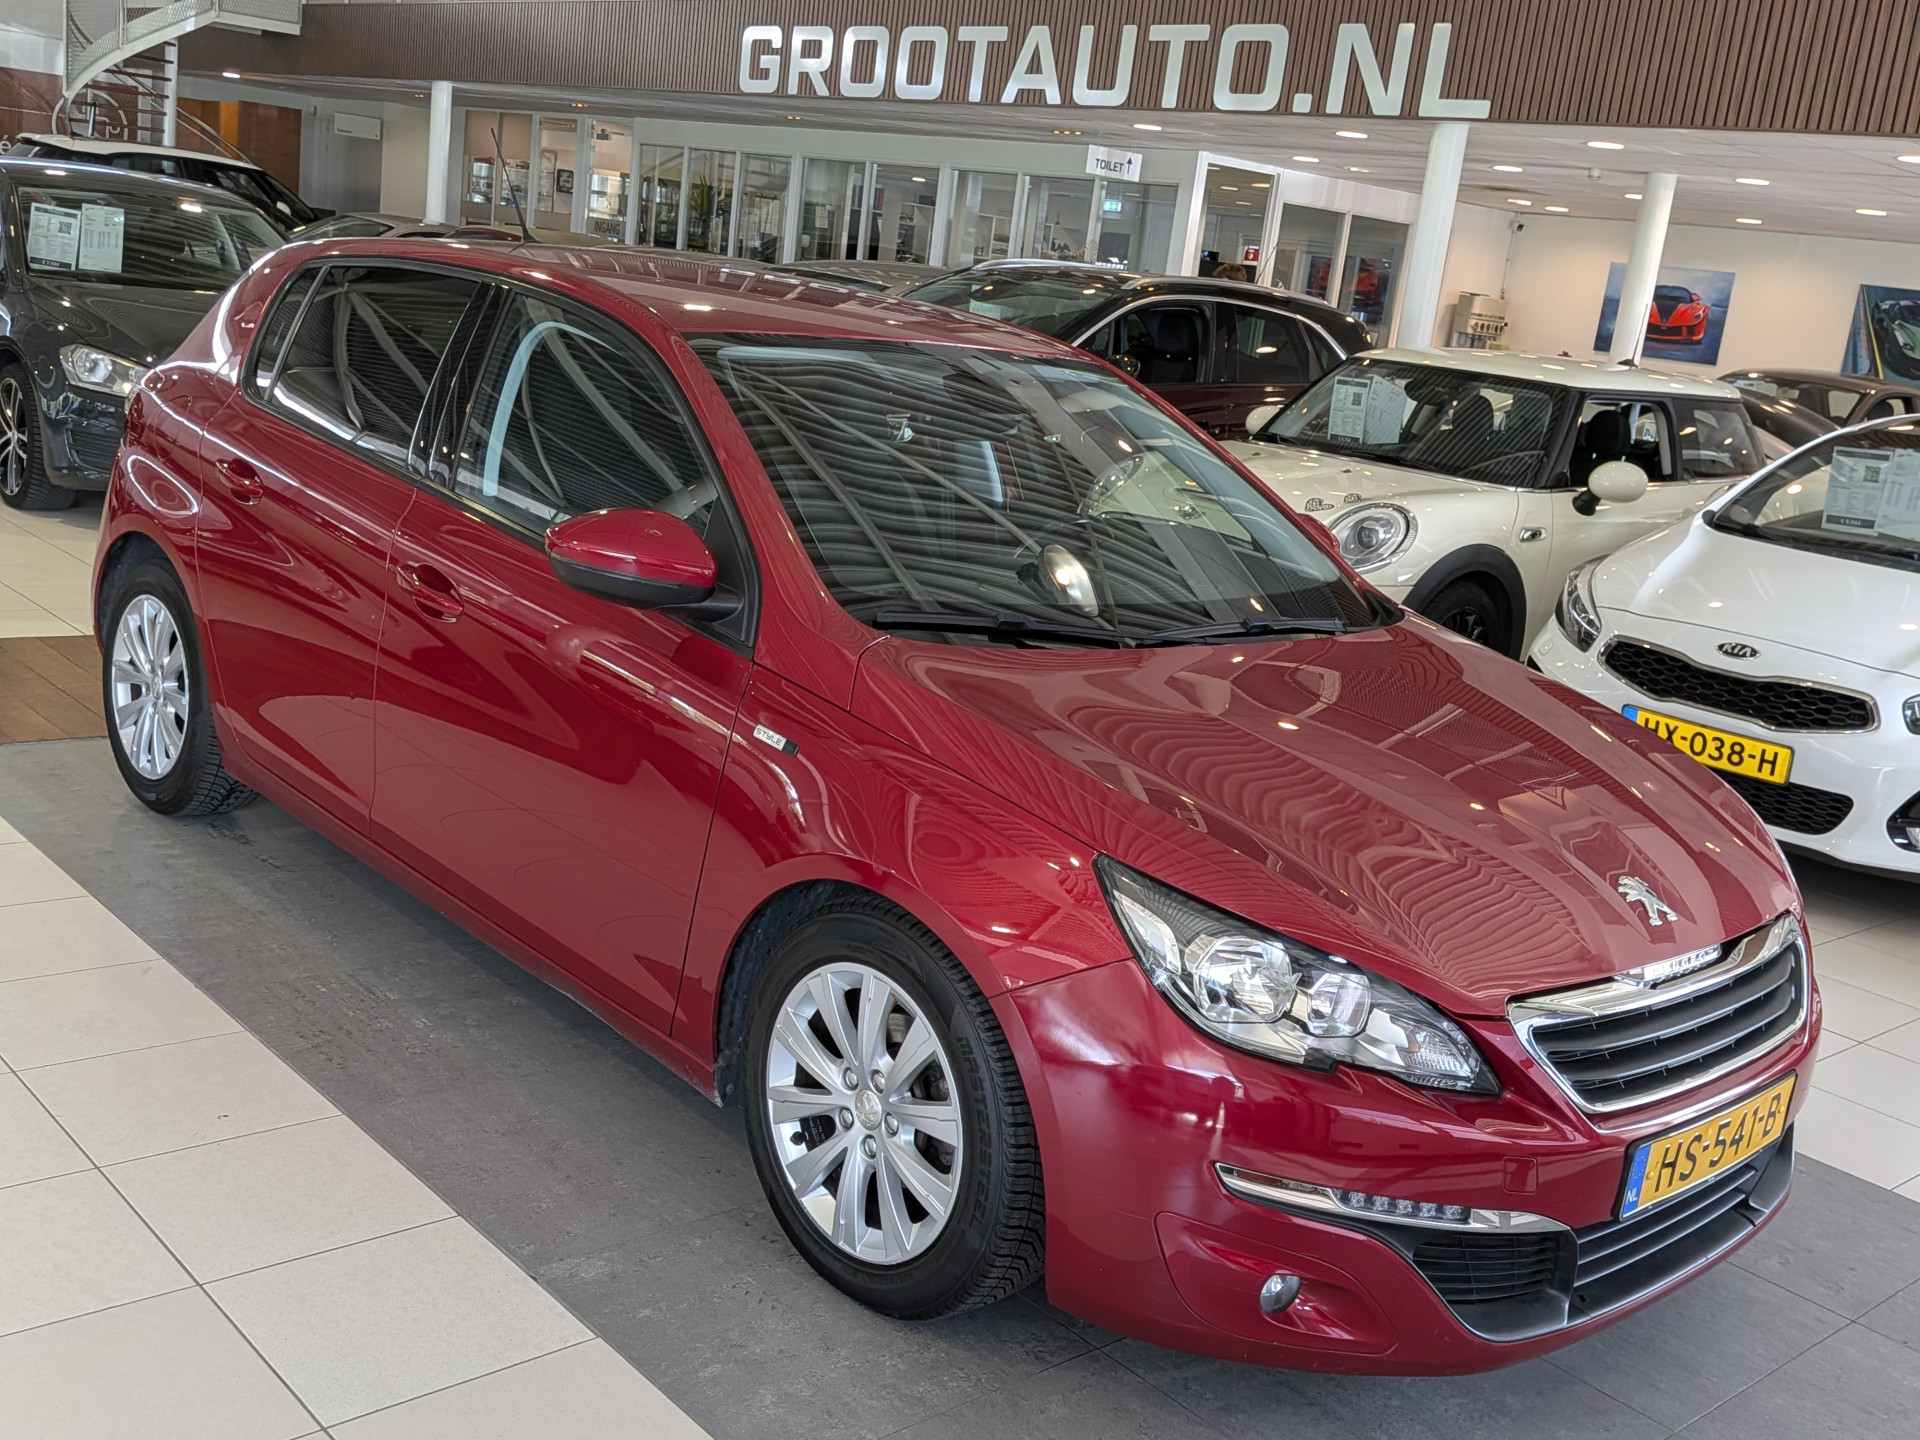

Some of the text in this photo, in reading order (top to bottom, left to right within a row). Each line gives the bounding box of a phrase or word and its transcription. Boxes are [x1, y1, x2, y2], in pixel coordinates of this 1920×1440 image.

[738, 22, 1492, 119] GROOTAUTO.NL
[1095, 157, 1125, 173] TOILET
[593, 220, 621, 235] INGANG
[1721, 643, 1752, 657] KIA
[756, 727, 783, 747] STYLE
[1654, 1092, 1782, 1193] HS-541-B
[1625, 1186, 1639, 1205] NL
